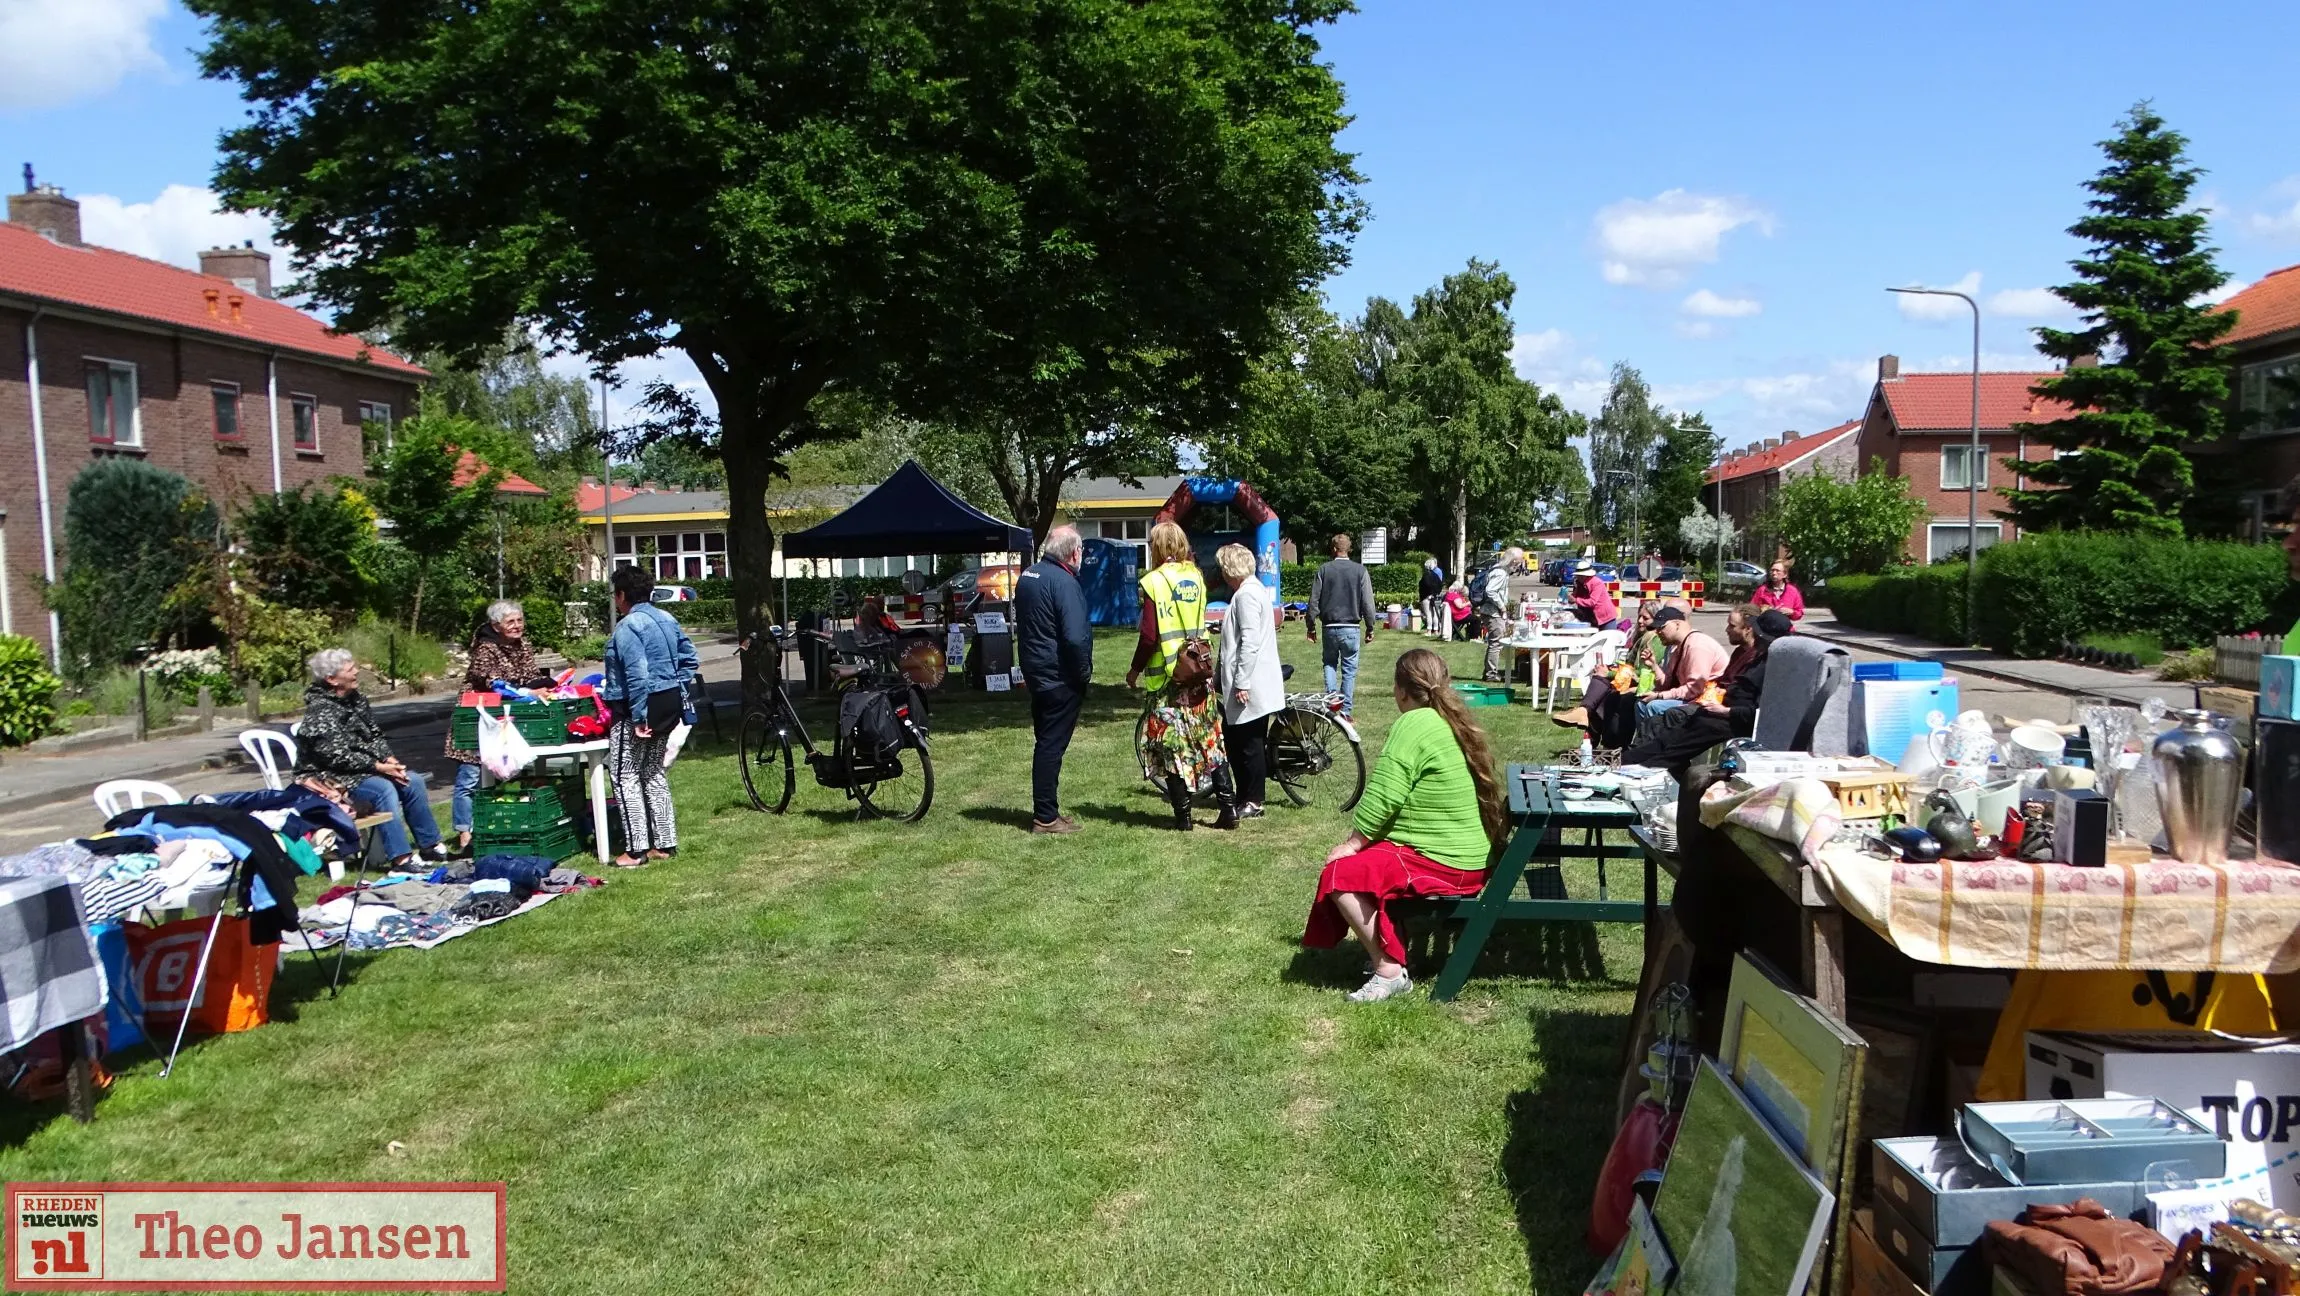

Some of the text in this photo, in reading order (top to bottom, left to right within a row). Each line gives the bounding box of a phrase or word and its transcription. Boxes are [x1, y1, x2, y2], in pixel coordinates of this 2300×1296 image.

[1158, 601, 1174, 618] ik
[901, 646, 912, 660] Sax
[927, 640, 941, 657] Tour
[157, 952, 190, 991] B
[2201, 1096, 2300, 1143] TOP
